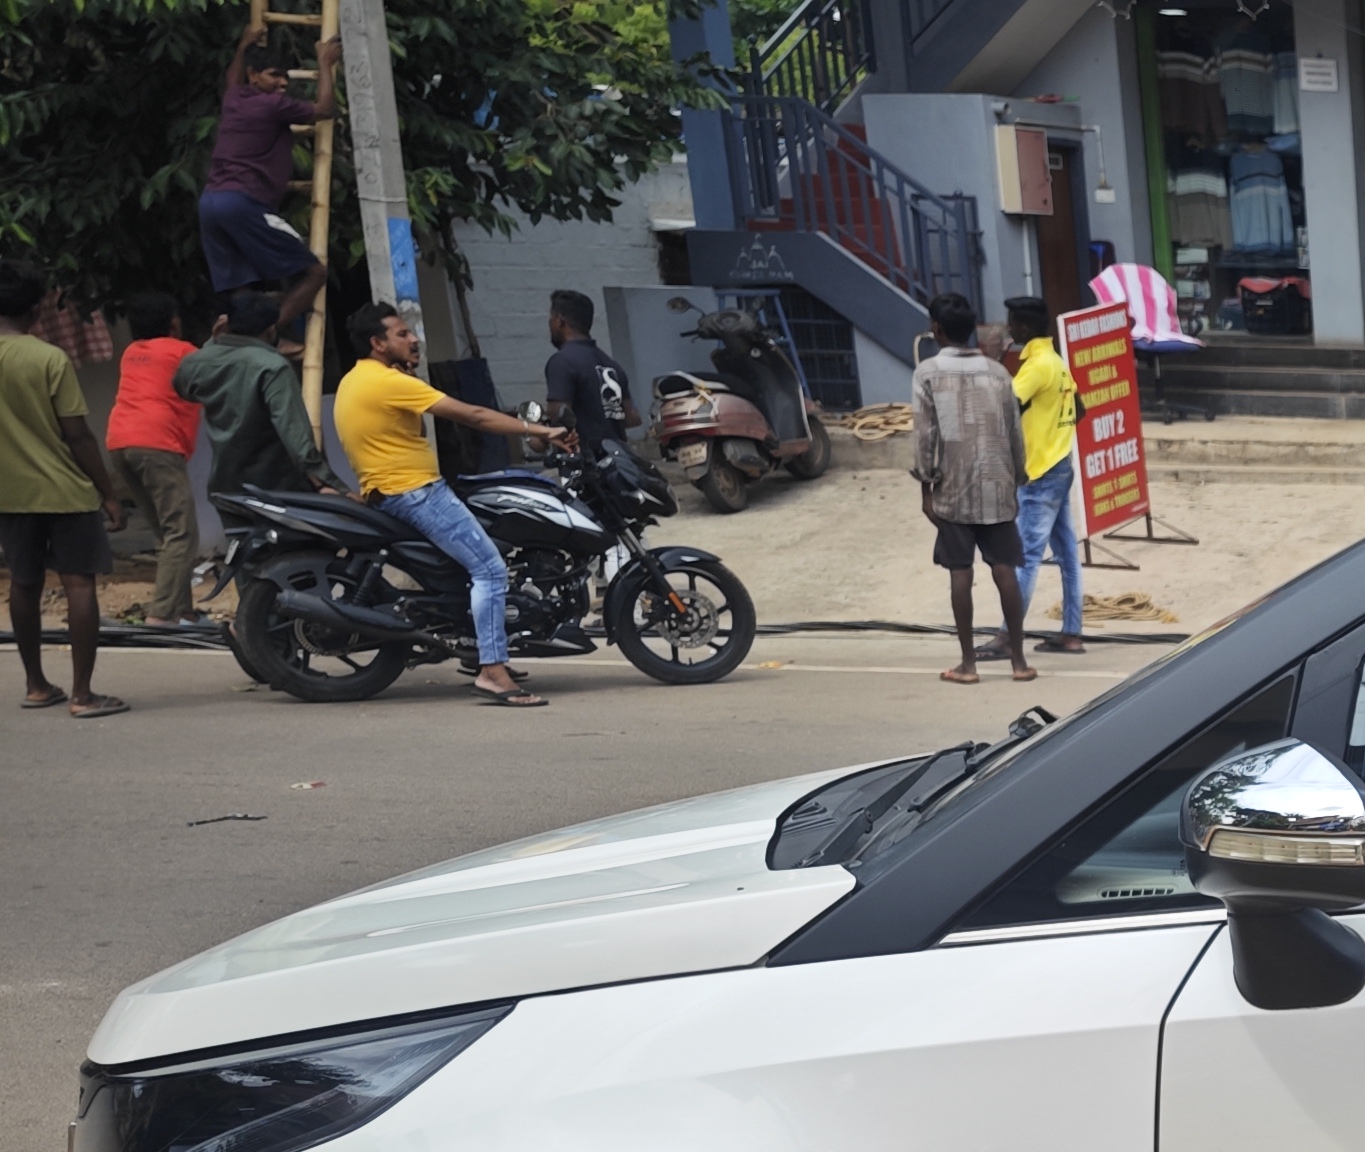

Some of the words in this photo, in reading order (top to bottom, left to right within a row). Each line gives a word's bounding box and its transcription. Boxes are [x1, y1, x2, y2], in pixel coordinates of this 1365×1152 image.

[1074, 348, 1092, 368] NEW
[1092, 337, 1127, 363] ARRIVALS
[1110, 379, 1131, 401] OFFER
[1092, 412, 1115, 442] BUY
[1116, 408, 1125, 435] 2
[1085, 449, 1106, 479] GET
[1106, 446, 1115, 471] 1
[1114, 436, 1139, 469] FREE
